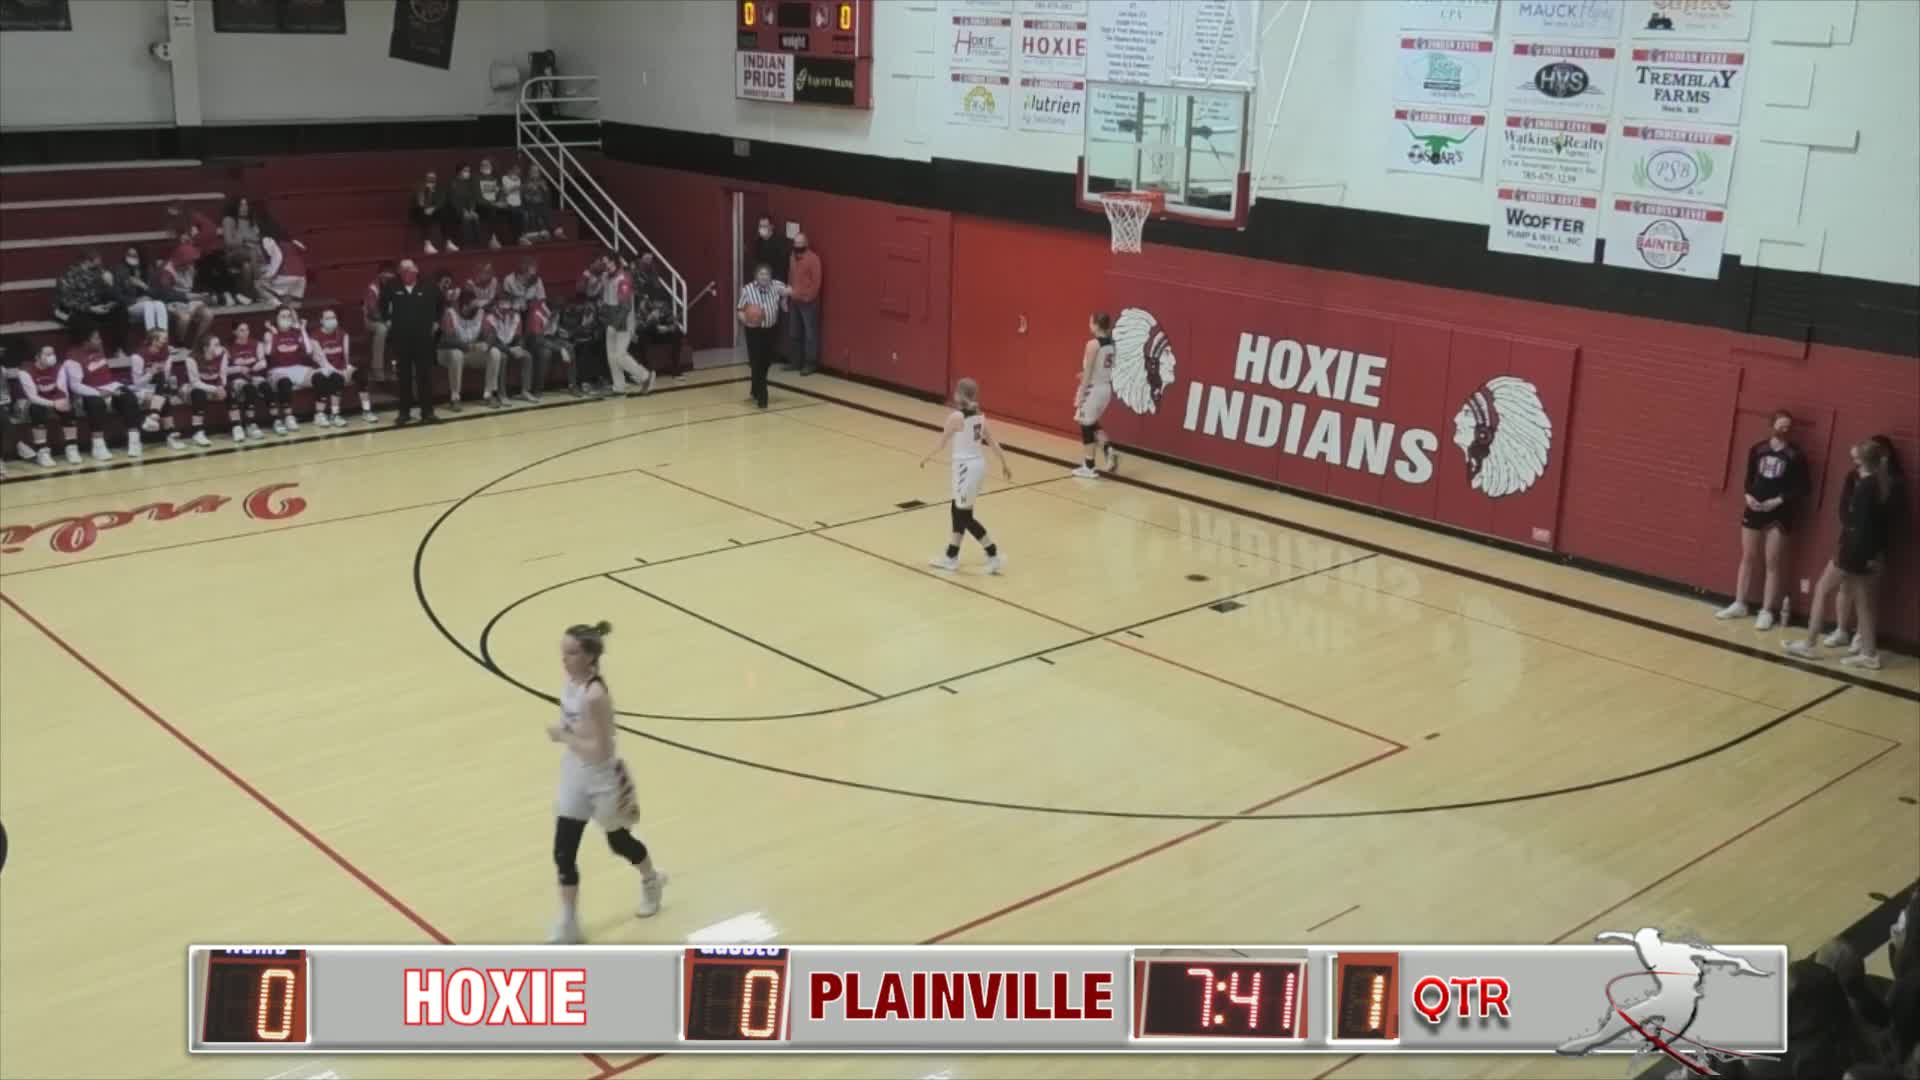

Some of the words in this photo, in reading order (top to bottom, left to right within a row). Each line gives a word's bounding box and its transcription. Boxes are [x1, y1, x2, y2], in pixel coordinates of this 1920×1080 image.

[743, 2, 754, 25] 0
[840, 5, 851, 29] 0
[1022, 36, 1087, 57] HOXIE
[744, 54, 785, 70] INDIAN
[744, 70, 785, 88] PRIDE
[1636, 66, 1738, 89] TREMBLAY
[1023, 94, 1080, 114] Nutrien
[1654, 87, 1711, 104] FARMS
[1504, 130, 1556, 146] Watkins
[1563, 134, 1603, 152] Realty
[1506, 207, 1585, 233] WOOFTER
[1234, 331, 1387, 408] HOXIE
[1183, 381, 1439, 484] INDIANS
